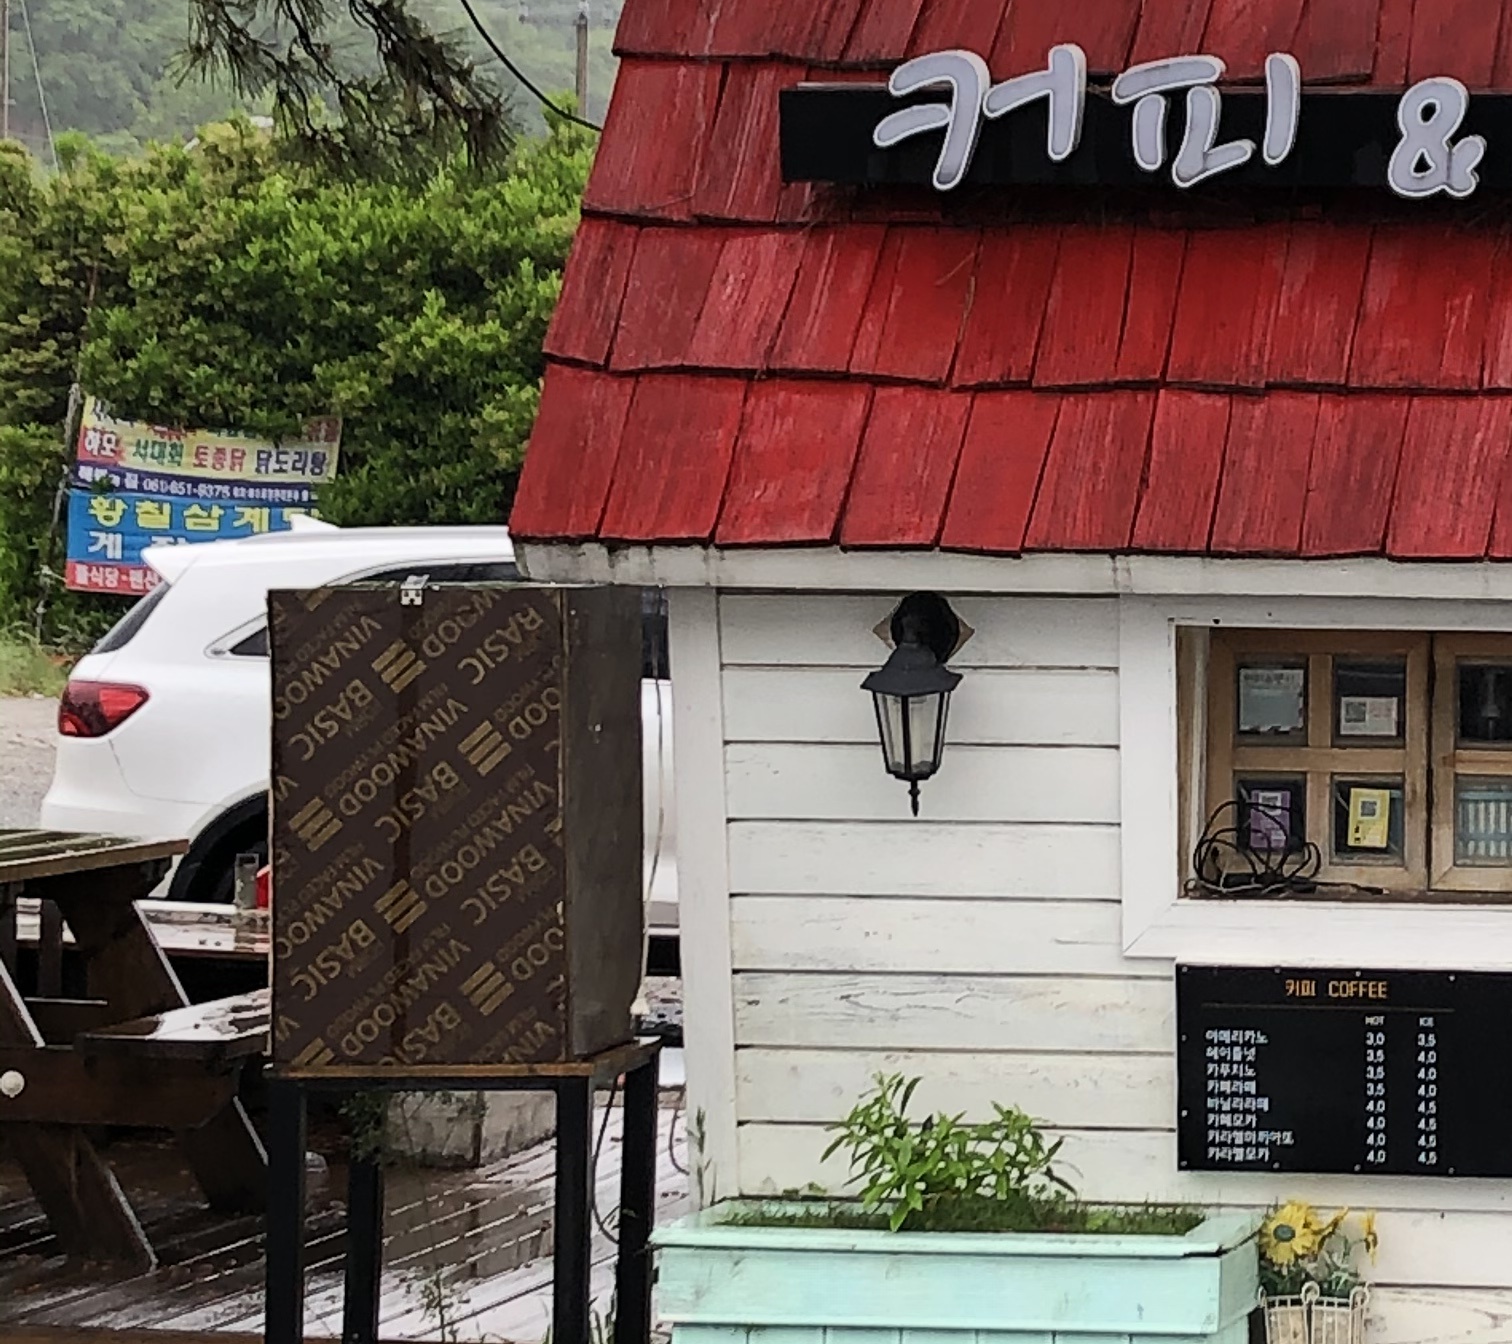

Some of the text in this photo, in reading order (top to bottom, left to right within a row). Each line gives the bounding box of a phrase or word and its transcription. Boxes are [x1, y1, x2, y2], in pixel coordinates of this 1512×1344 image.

[872, 43, 1301, 192] 커피
[1386, 75, 1487, 198] &
[192, 445, 247, 472] 토종닭
[255, 448, 328, 476] 닭도리탕
[286, 678, 374, 761] BASIC
[334, 694, 469, 819] VINAWOOD
[372, 760, 460, 842] BASIC
[420, 776, 556, 901] VINAWOOD
[458, 843, 546, 925] BASIC
[288, 918, 376, 1001] BASIC
[336, 934, 471, 1059] VINAWOOD
[1328, 980, 1388, 999] COFFEE
